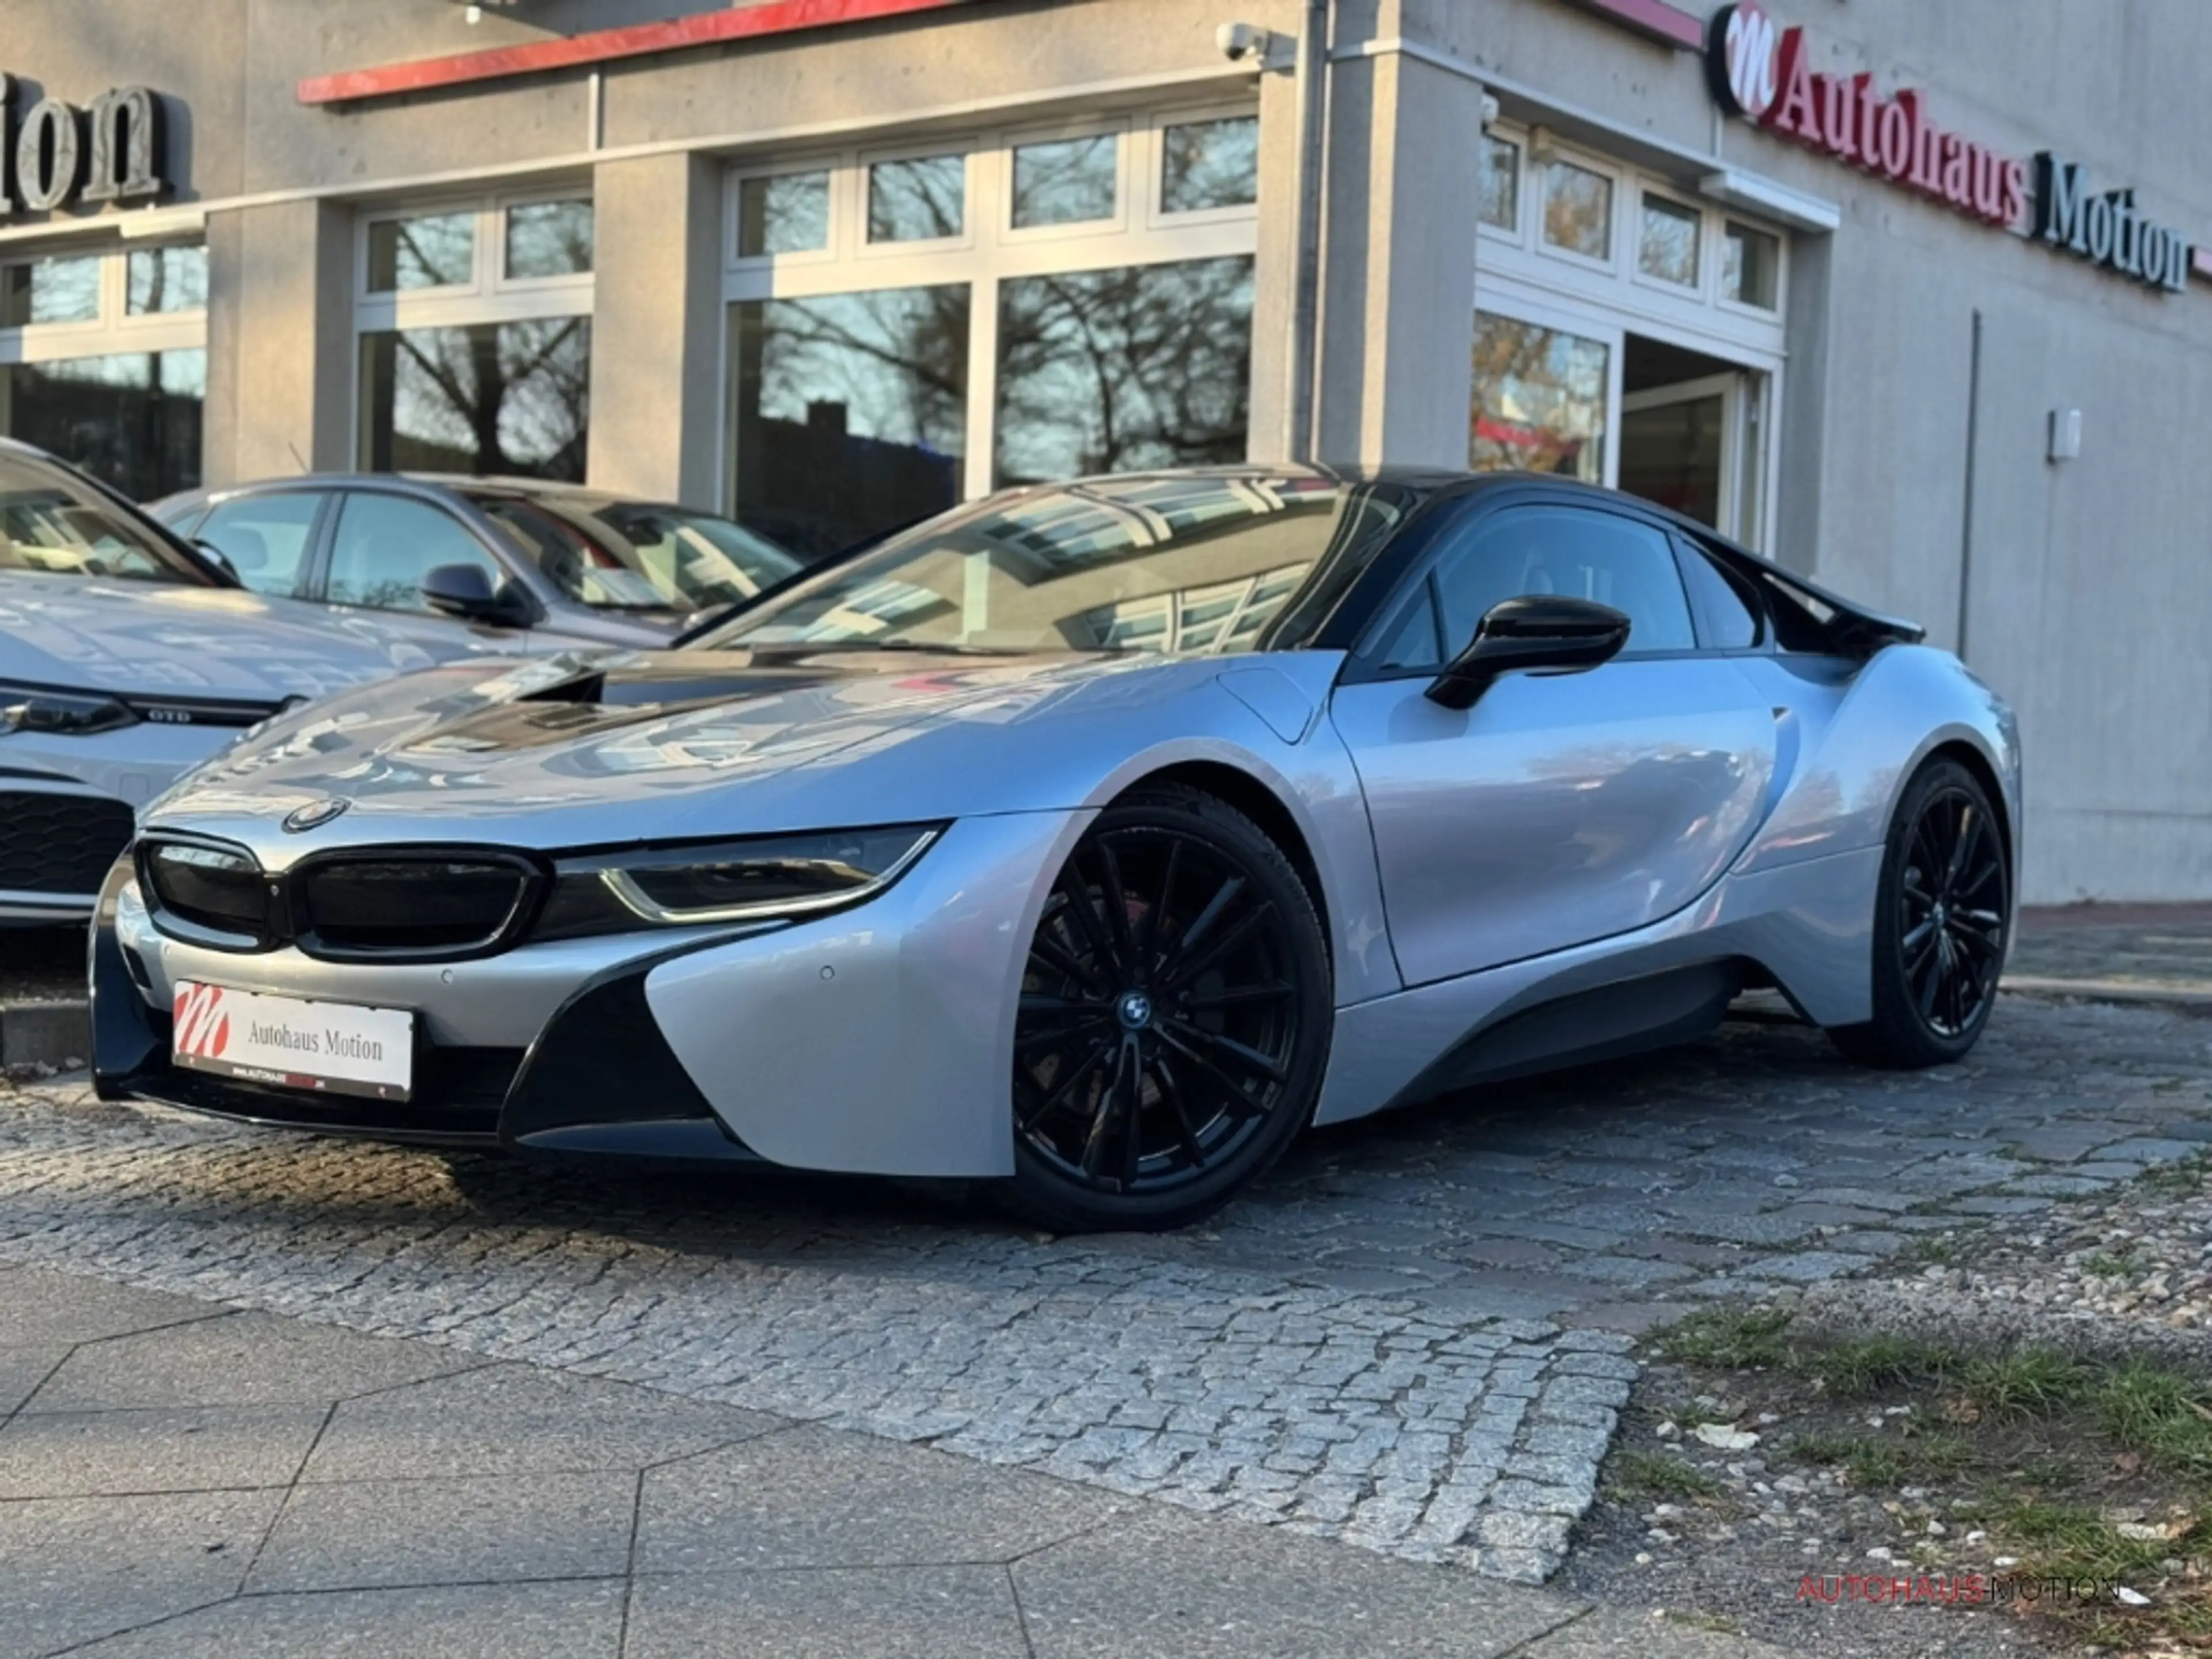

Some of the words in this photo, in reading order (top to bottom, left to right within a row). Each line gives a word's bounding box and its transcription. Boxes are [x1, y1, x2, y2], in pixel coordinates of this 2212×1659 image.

[0, 71, 161, 214] on
[1776, 26, 2028, 227] Autohaus
[2045, 153, 2187, 289] Motion
[248, 1019, 319, 1052] Autohaus
[324, 1028, 382, 1060] Motion
